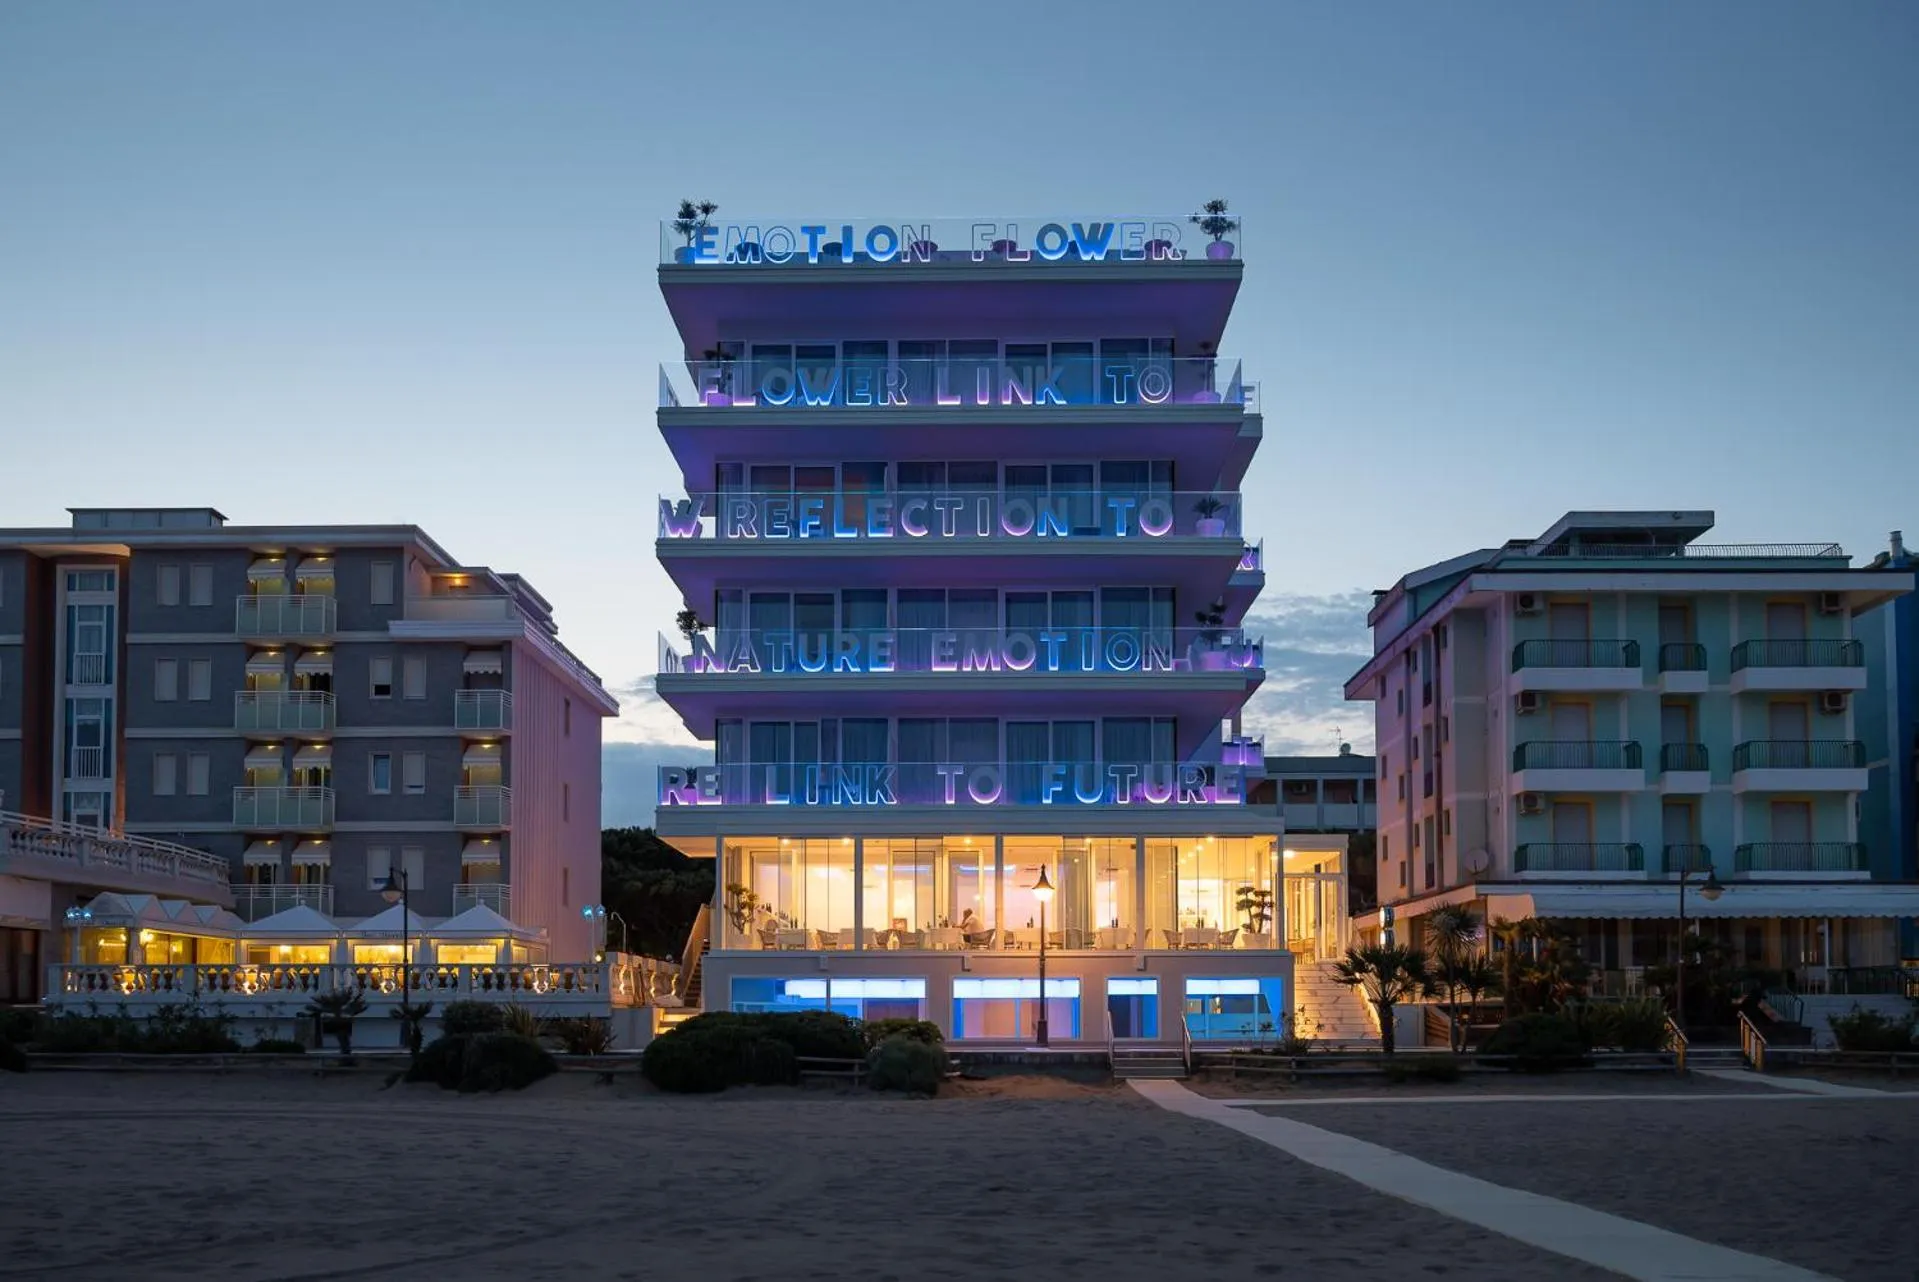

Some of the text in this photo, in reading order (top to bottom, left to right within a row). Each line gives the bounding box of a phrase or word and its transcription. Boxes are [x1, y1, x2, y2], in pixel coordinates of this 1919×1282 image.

[694, 222, 1183, 264] EMOTION FLOWER
[699, 365, 1172, 406] FLOWER LINK TO
[727, 497, 1173, 538] REFLECTION TO
[694, 633, 895, 673] NATURE
[931, 631, 1172, 671] EMOTION
[660, 764, 1242, 806] RE LINK TO FUTURE
